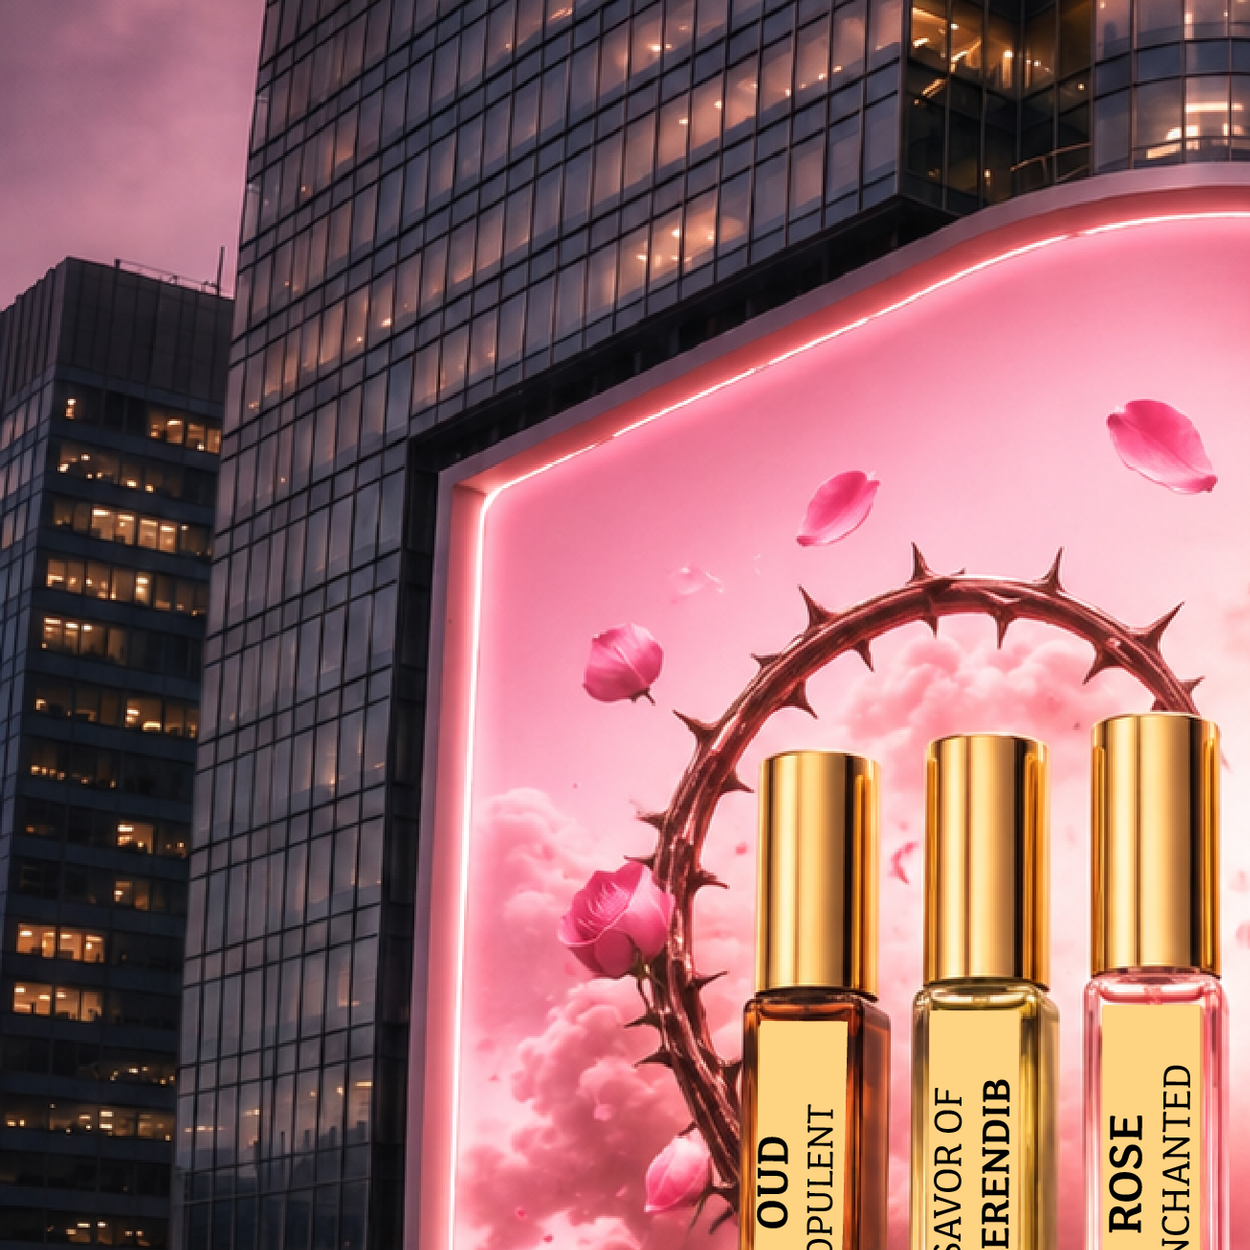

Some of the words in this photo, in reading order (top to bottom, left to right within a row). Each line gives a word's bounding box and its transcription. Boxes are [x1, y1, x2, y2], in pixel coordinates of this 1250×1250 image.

[933, 1087, 963, 1134] OF
[757, 1136, 789, 1229] OUD
[1108, 1114, 1143, 1234] ROSE
